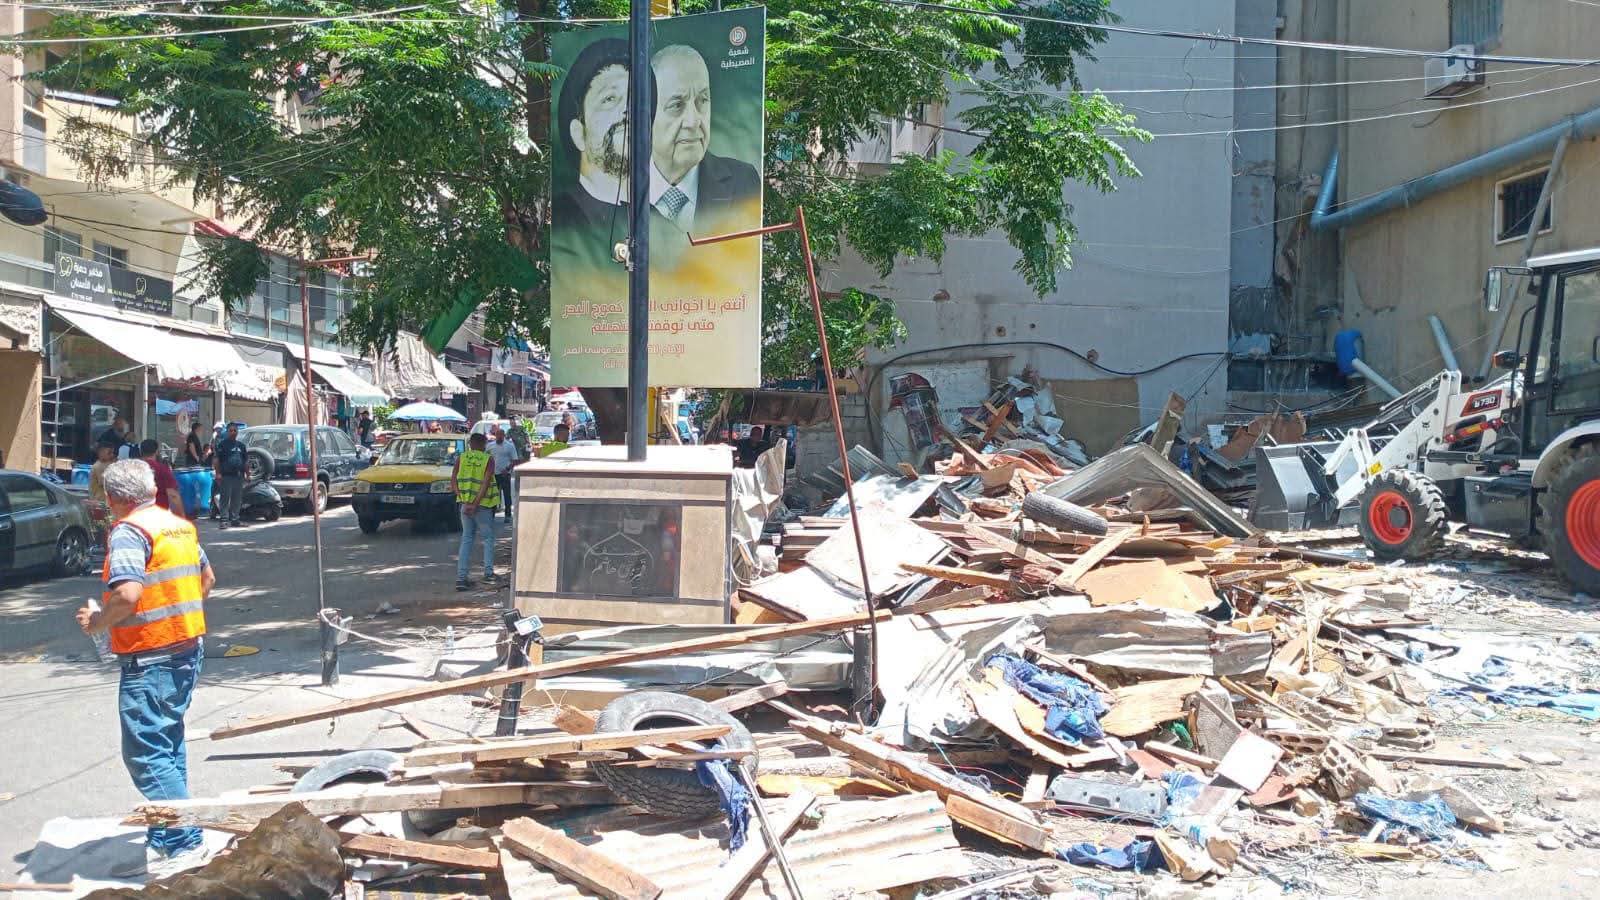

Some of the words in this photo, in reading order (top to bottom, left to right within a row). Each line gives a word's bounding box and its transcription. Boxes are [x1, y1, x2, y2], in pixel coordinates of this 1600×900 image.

[728, 46, 749, 57] شعبة
[563, 301, 590, 318] البحر
[592, 300, 624, 319] كموج
[706, 299, 716, 313] يا
[721, 295, 747, 316] أنتم
[648, 319, 684, 334] توقفت
[687, 318, 715, 332] متى
